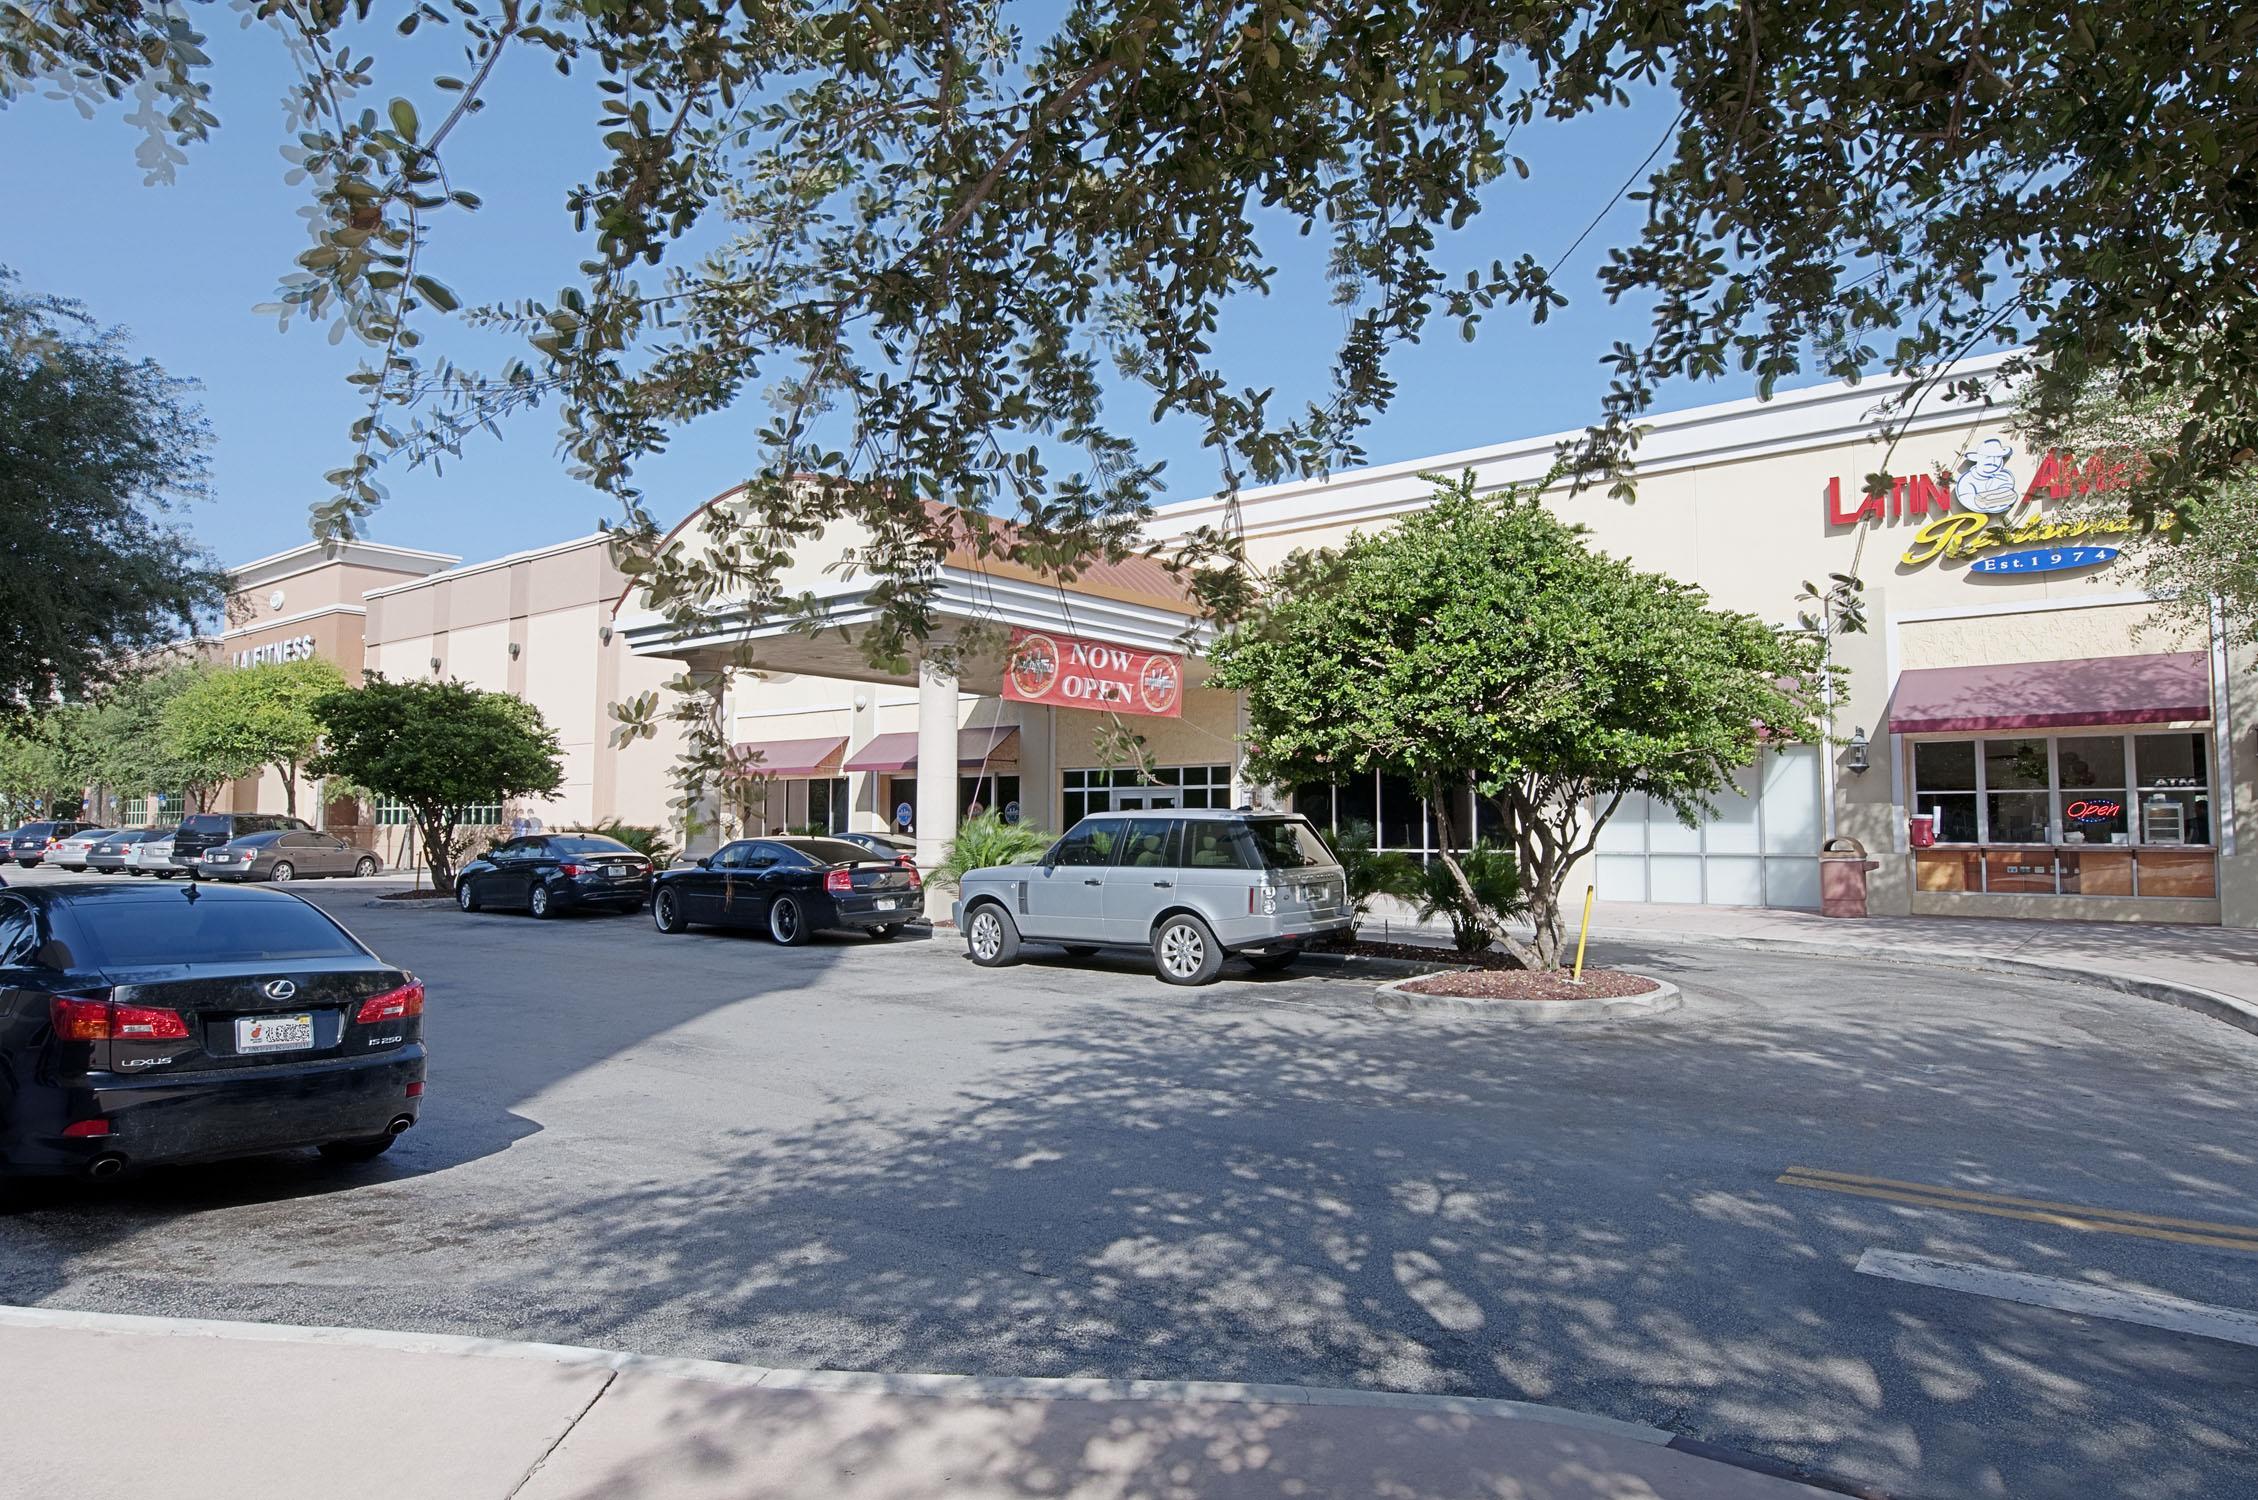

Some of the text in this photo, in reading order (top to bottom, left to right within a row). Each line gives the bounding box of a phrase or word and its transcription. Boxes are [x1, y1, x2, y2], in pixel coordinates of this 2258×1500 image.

[1829, 472, 1951, 526] LATIN
[1984, 559, 2024, 571] Est.
[253, 634, 315, 668] FITNESS
[1070, 643, 1135, 673] NOW
[1062, 675, 1135, 705] OPEN
[2155, 778, 2197, 787] ATM
[2067, 800, 2120, 818] Open
[381, 1035, 402, 1045] 250
[121, 1057, 172, 1067] LEXUS
